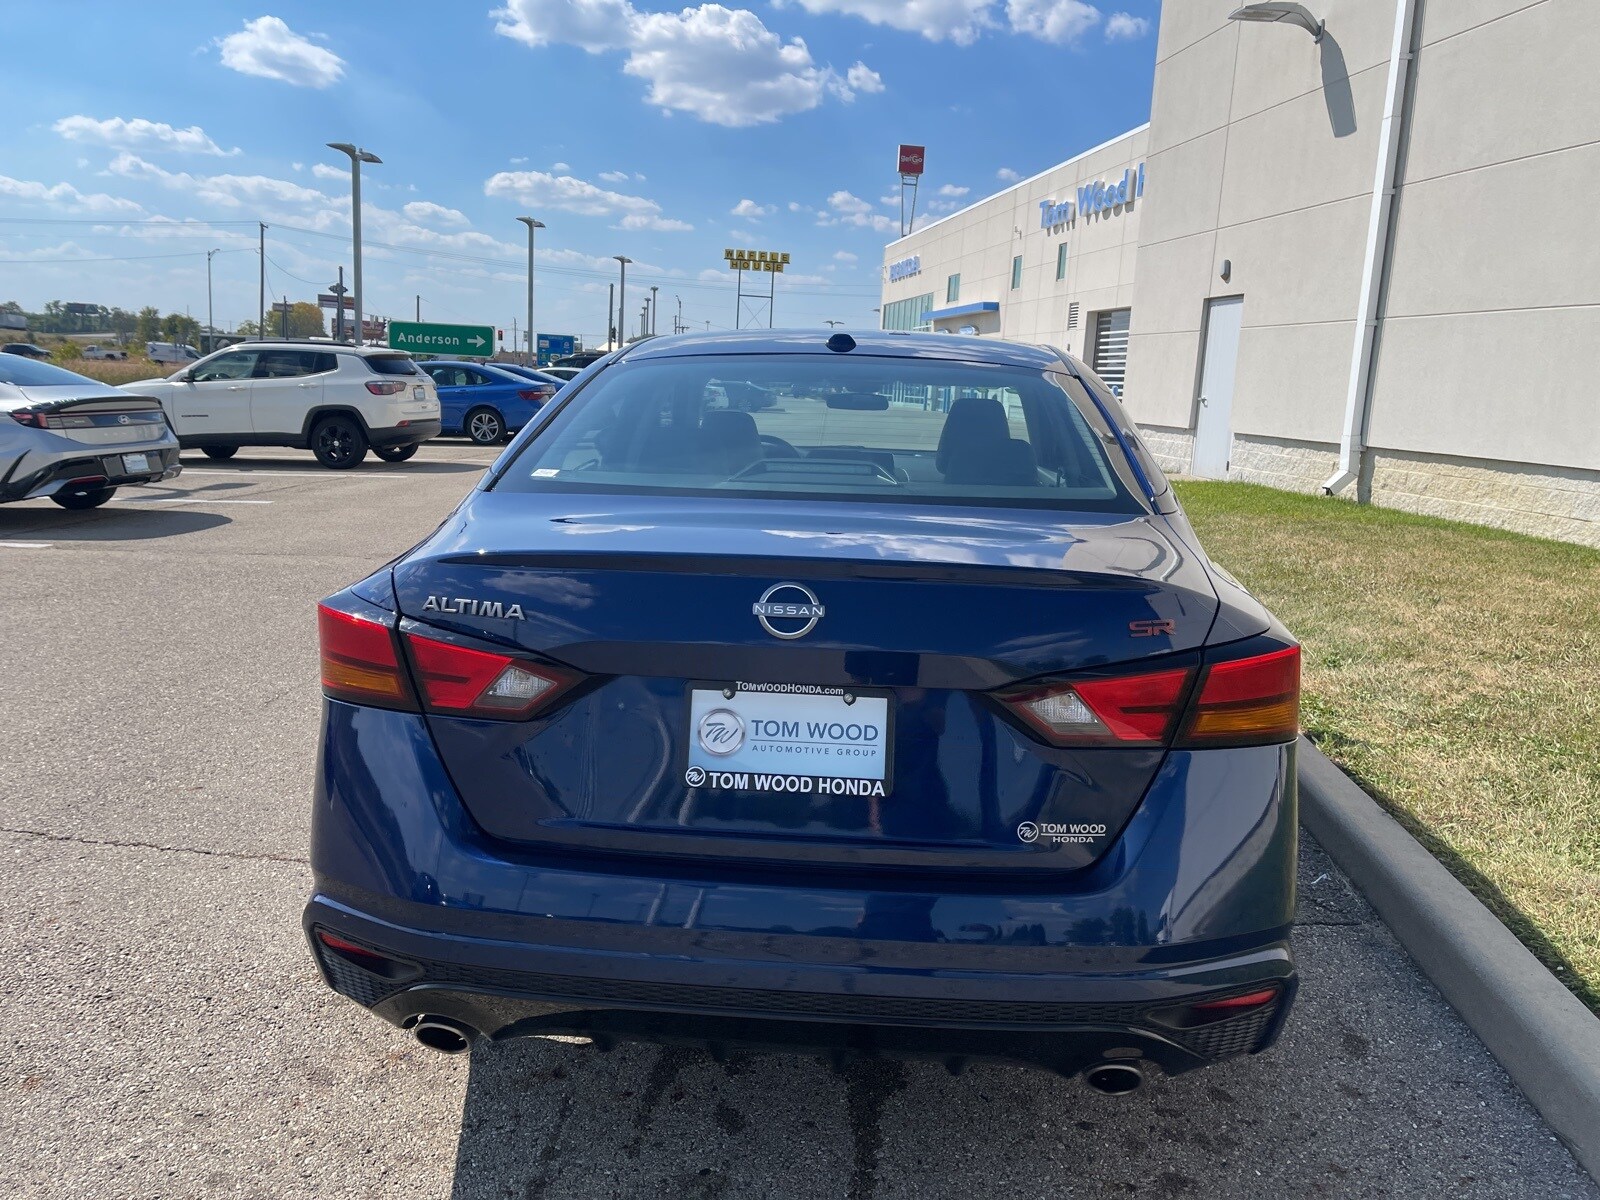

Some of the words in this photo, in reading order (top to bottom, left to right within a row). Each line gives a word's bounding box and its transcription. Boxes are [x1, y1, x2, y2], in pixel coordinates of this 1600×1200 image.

[1040, 200, 1076, 229] Tom
[1077, 169, 1135, 217] Wood
[726, 250, 788, 262] WAFFLE
[731, 261, 782, 271] HOUSE
[397, 332, 460, 346] Anderson
[422, 595, 526, 621] ALTIMA
[754, 603, 824, 616] NISSAN
[1129, 619, 1176, 638] SR
[751, 720, 800, 738] TOM
[807, 722, 879, 741] WOOD
[752, 745, 830, 755] AUTOMOTIVE
[836, 748, 877, 757] GROUP
[709, 772, 749, 790] TOM
[754, 775, 813, 793] WOOD
[818, 778, 885, 797] HONDA
[1040, 823, 1067, 833] TOM
[1069, 824, 1106, 834] WOOD
